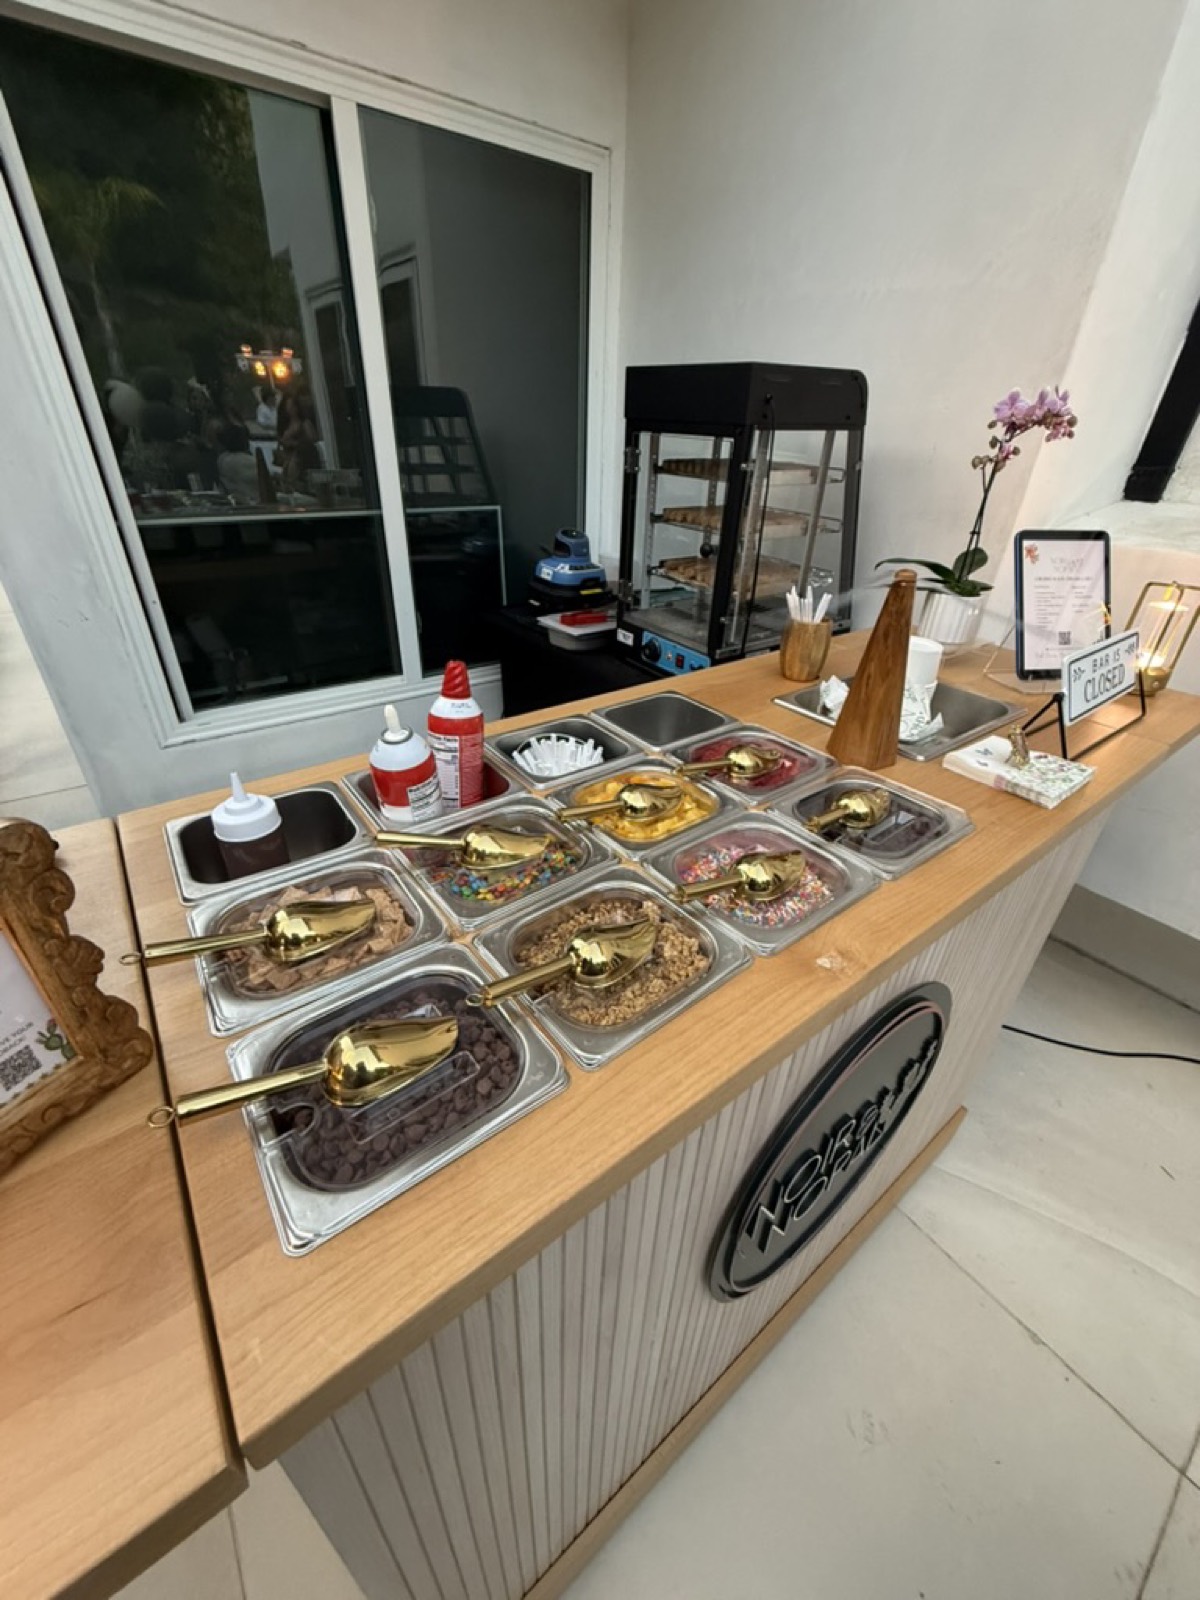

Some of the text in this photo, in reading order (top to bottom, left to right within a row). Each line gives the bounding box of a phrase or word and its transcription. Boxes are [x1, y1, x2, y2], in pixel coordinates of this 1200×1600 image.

[1092, 648, 1120, 673] BAR IS
[1084, 663, 1125, 704] CLOSED
